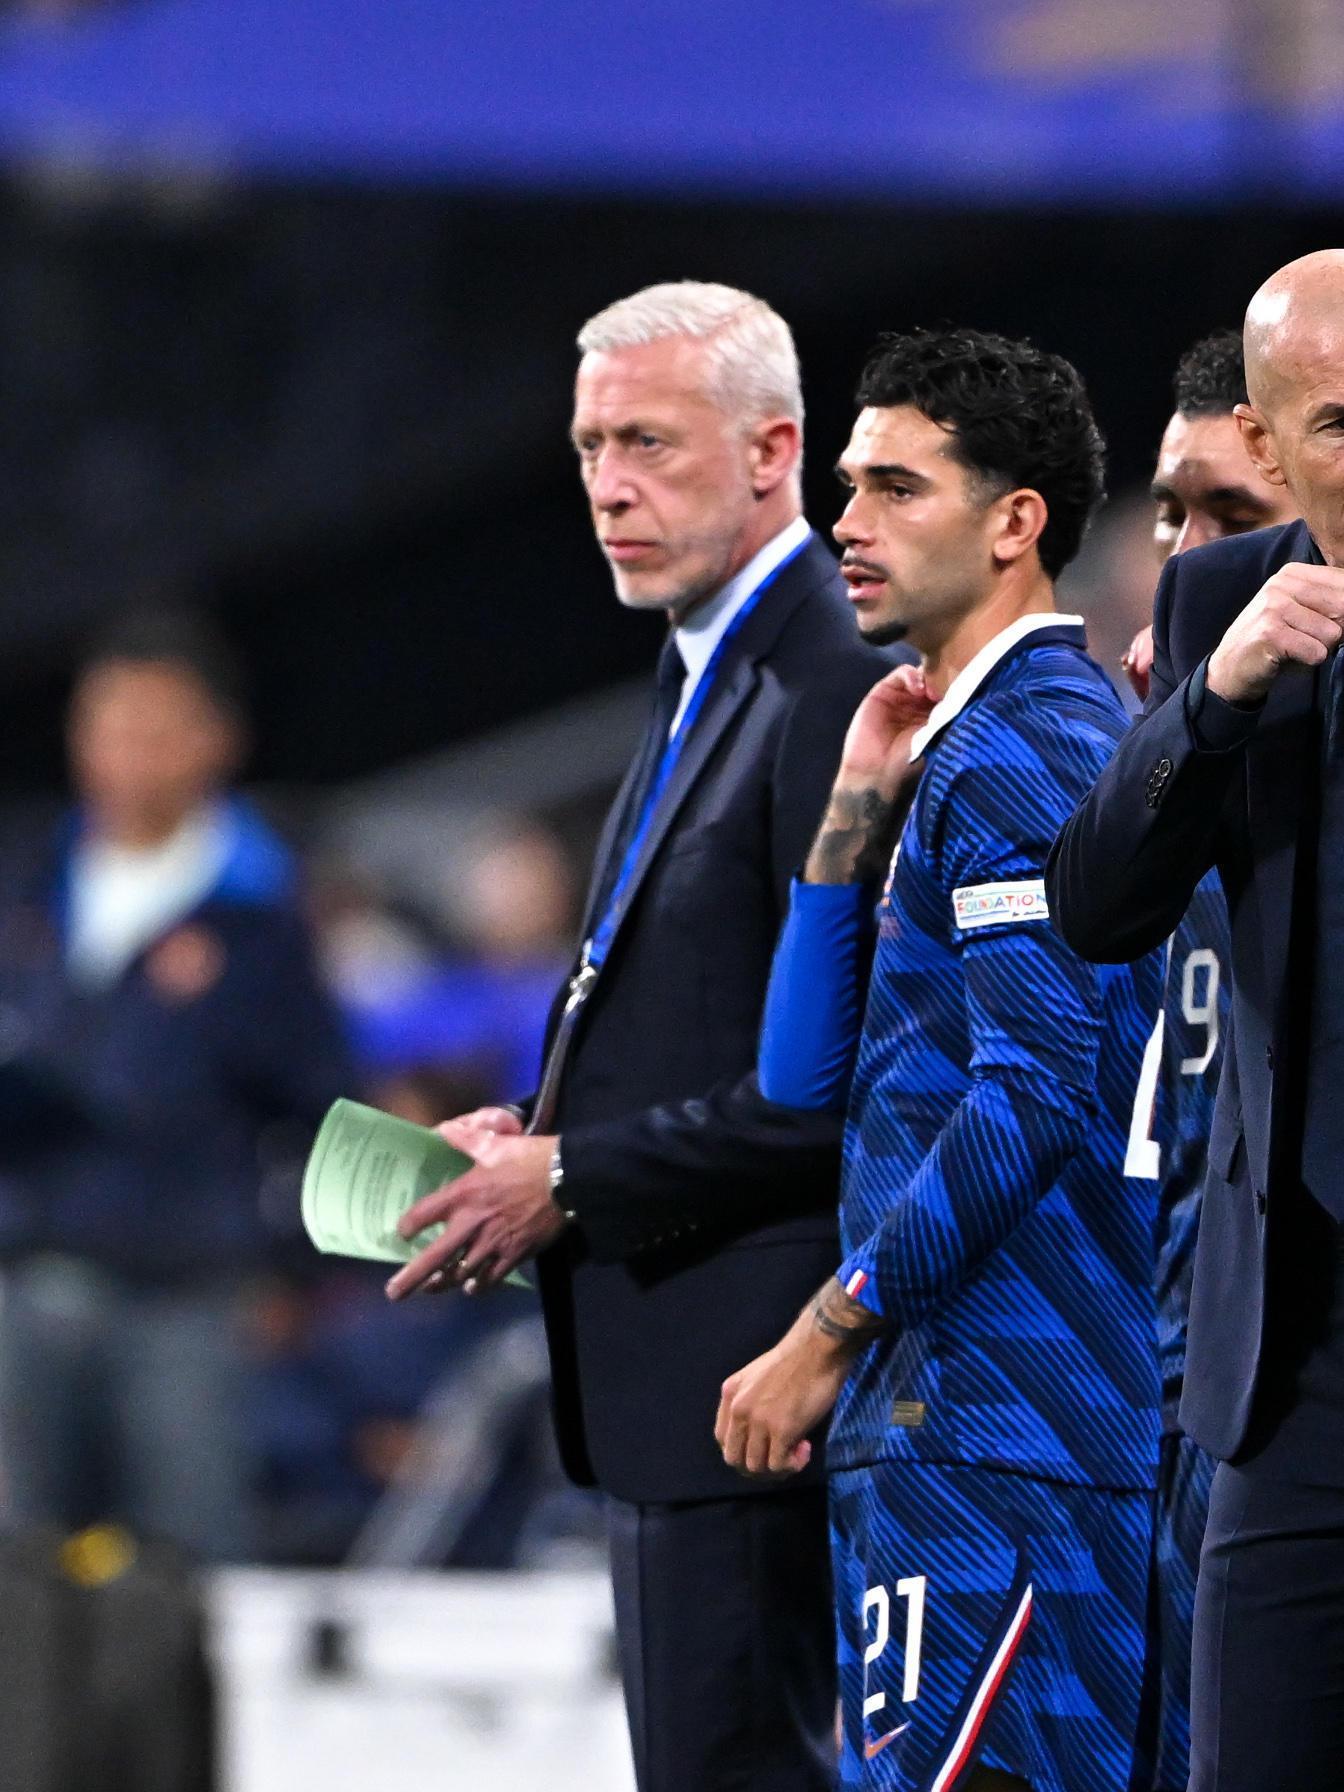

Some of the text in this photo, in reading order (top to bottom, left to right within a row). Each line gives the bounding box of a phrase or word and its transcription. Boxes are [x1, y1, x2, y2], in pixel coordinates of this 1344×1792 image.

[957, 894, 1046, 914] FOUNDATION
[1181, 949, 1220, 1075] 9
[863, 1576, 926, 1720] 21
